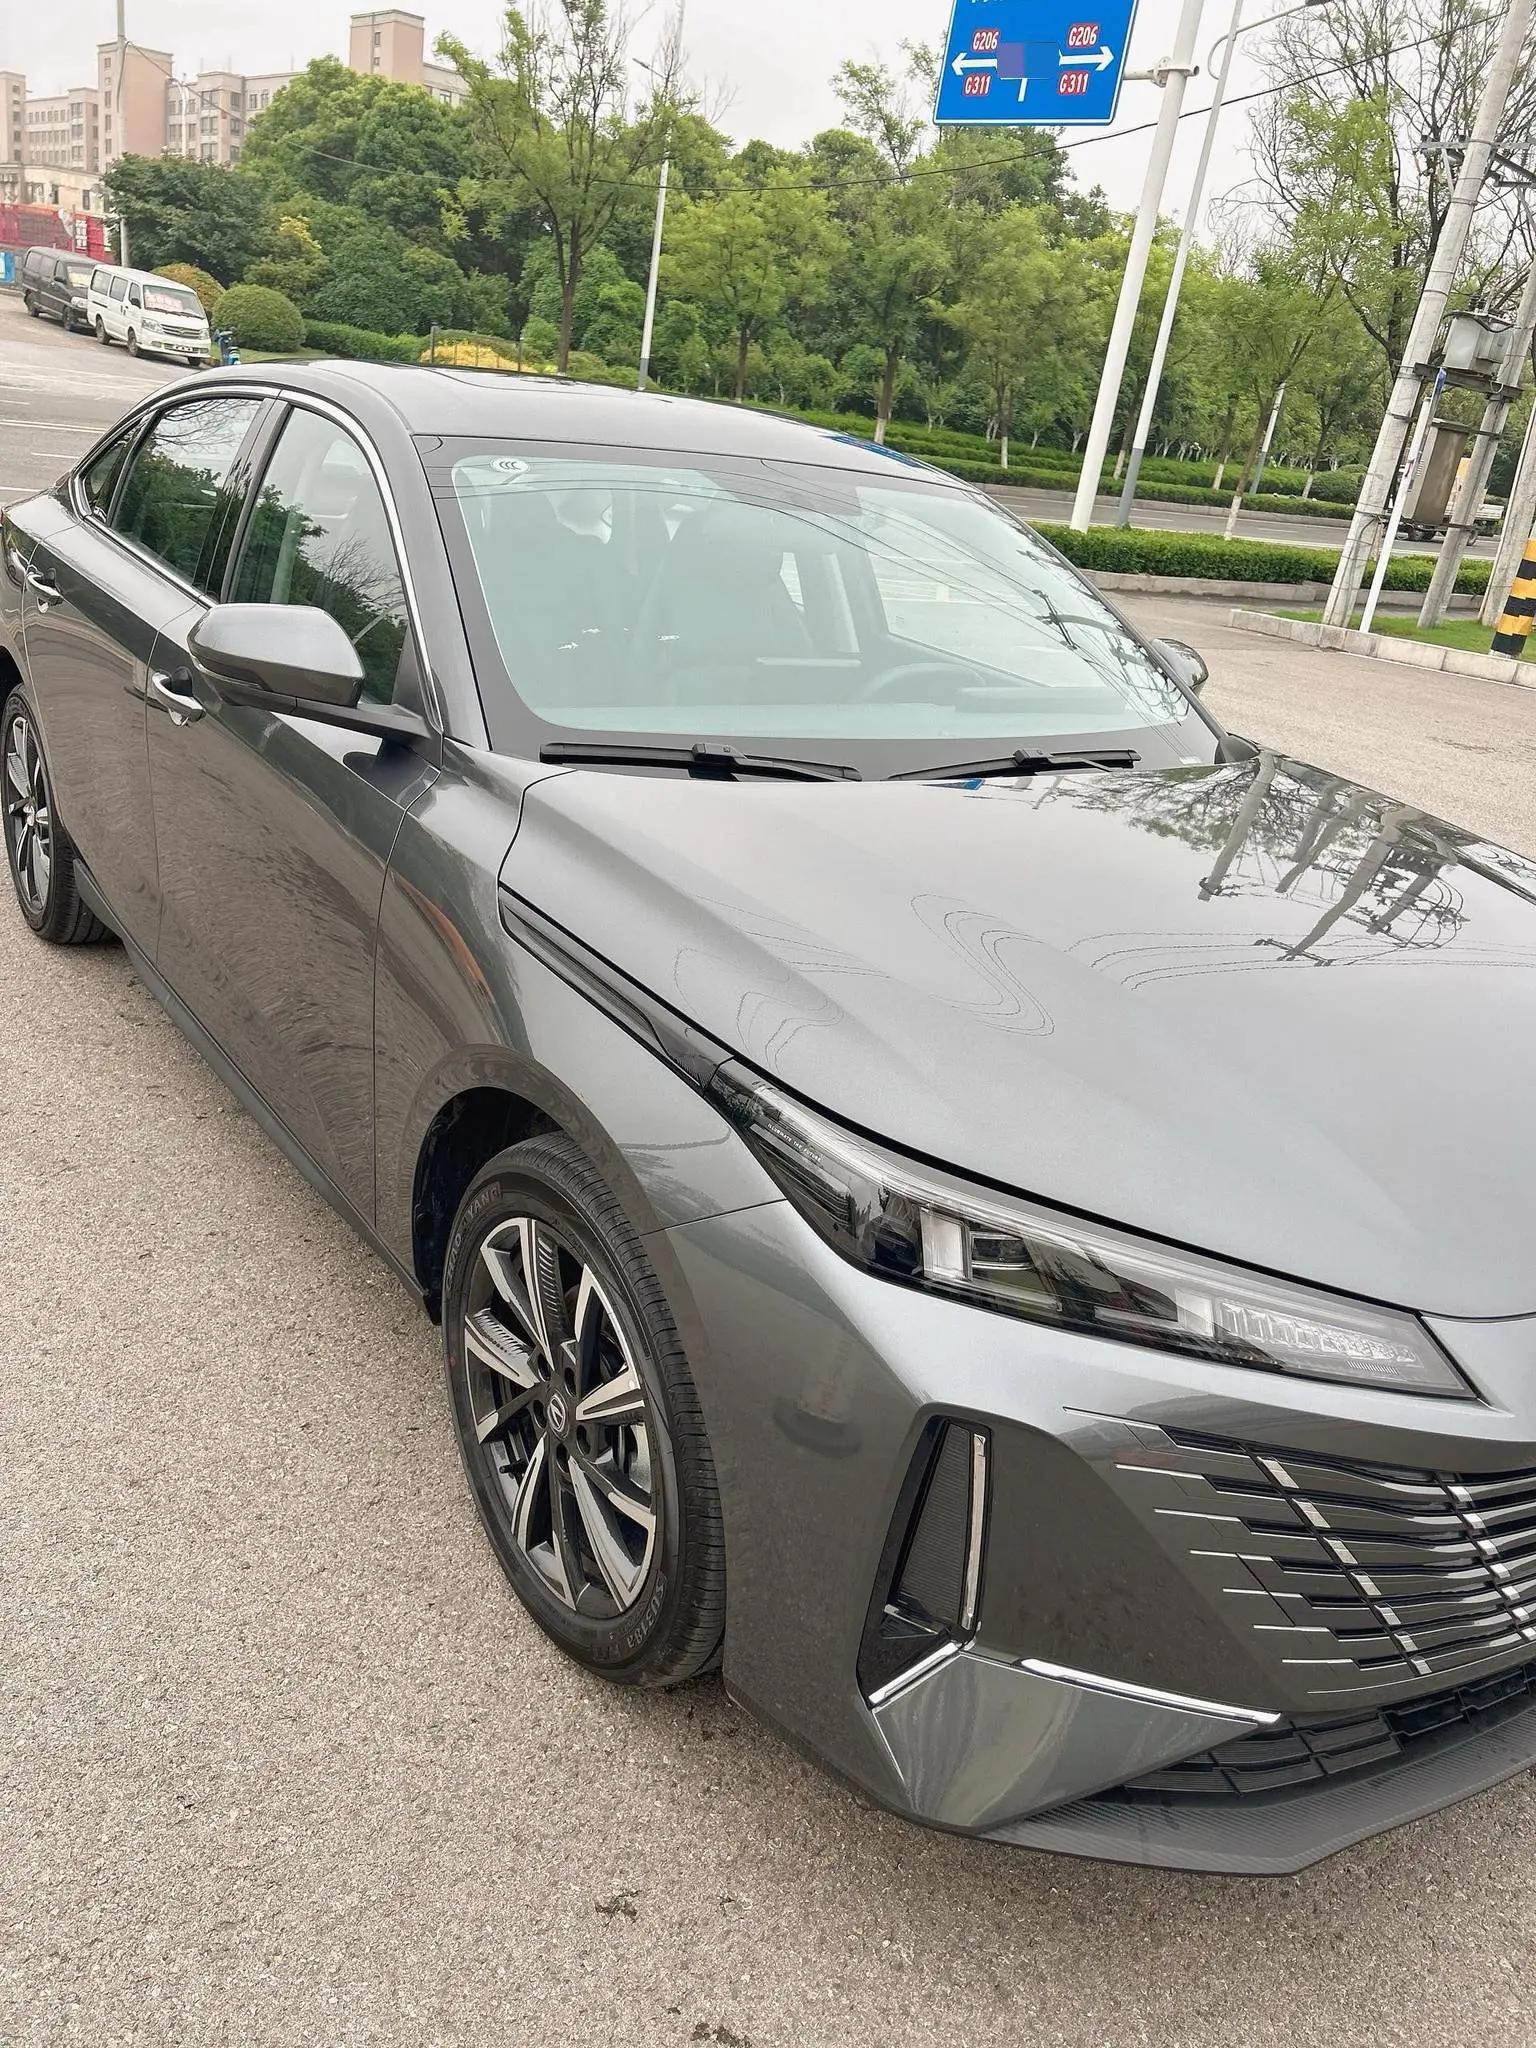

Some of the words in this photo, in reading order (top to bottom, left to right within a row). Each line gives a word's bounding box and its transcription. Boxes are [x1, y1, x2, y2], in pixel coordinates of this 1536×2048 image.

[972, 31, 999, 50] G206
[1068, 26, 1099, 46] G206
[964, 75, 992, 95] G311
[1059, 73, 1089, 93] G311
